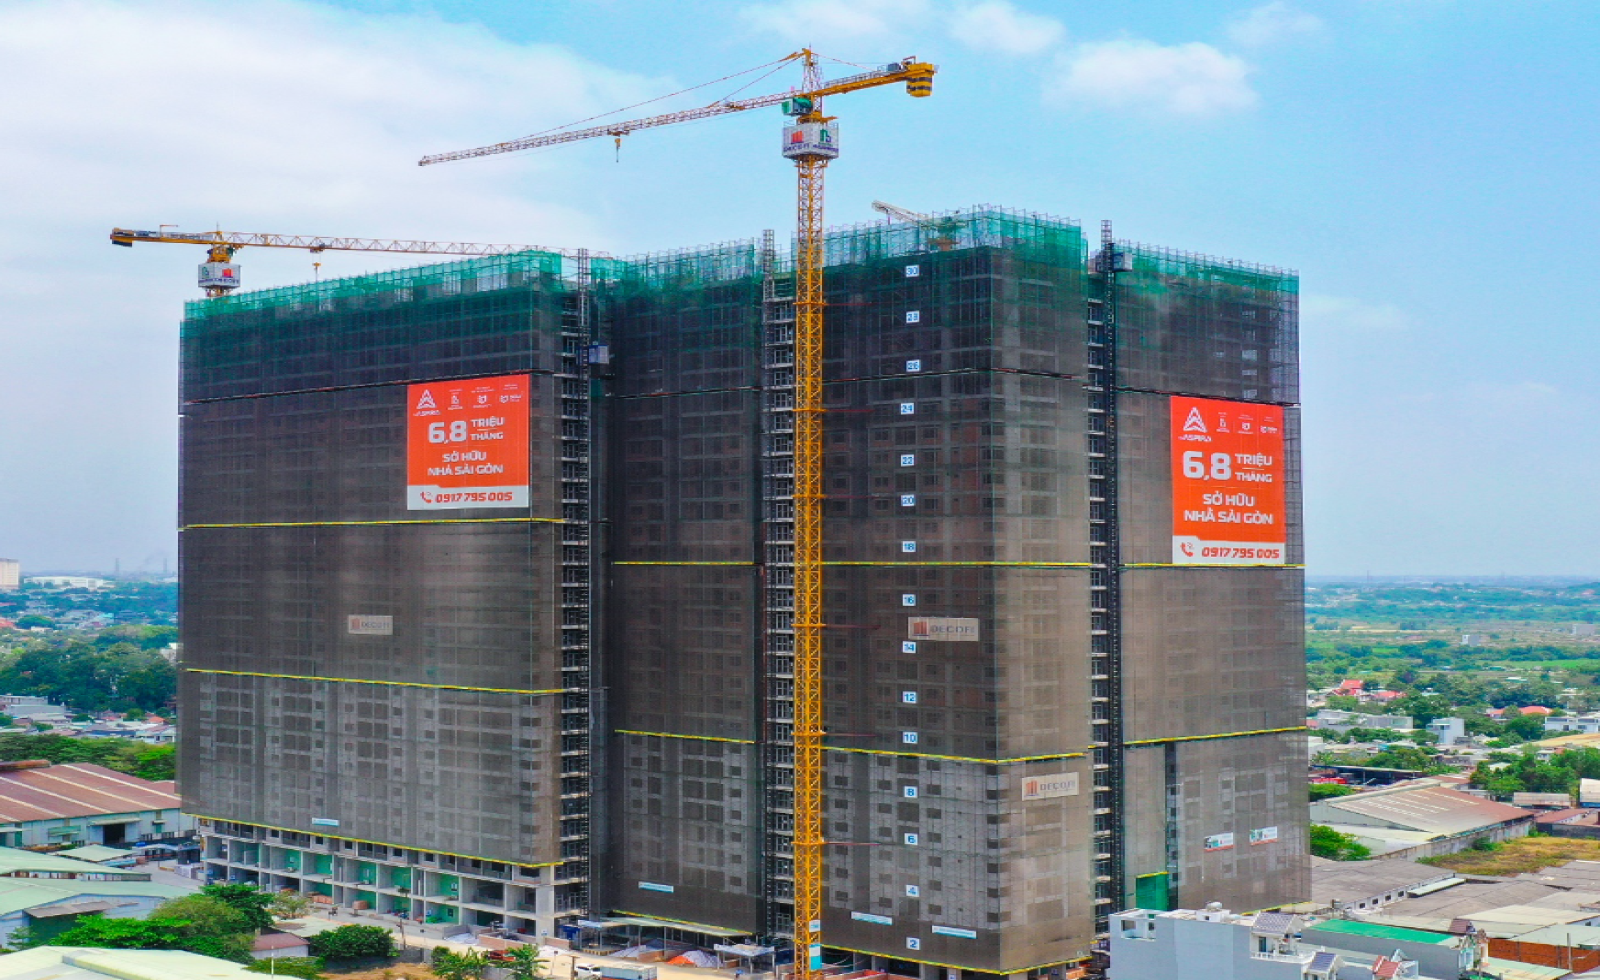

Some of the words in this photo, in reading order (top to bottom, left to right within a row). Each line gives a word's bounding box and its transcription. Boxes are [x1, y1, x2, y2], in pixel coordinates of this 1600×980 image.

[906, 266, 919, 275] 30
[470, 416, 505, 427] TRIỆU
[428, 420, 468, 444] 6,8
[470, 431, 503, 440] THÁNG
[442, 450, 459, 463] SỞ
[462, 450, 487, 461] HỮU
[1235, 452, 1272, 466] TRIỆU
[427, 465, 453, 476] NHÀ
[455, 465, 474, 476] SÀI
[477, 464, 503, 474] GÒN
[1183, 450, 1232, 481] 6,8
[1235, 470, 1272, 483] THÁNG
[1202, 490, 1223, 506] SỞ
[1225, 493, 1255, 506] HỮU
[1183, 509, 1215, 523] NHÀ
[1218, 511, 1241, 524] SÀI
[1243, 512, 1273, 525] GÒN
[904, 693, 916, 702] 12
[904, 733, 916, 742] 10
